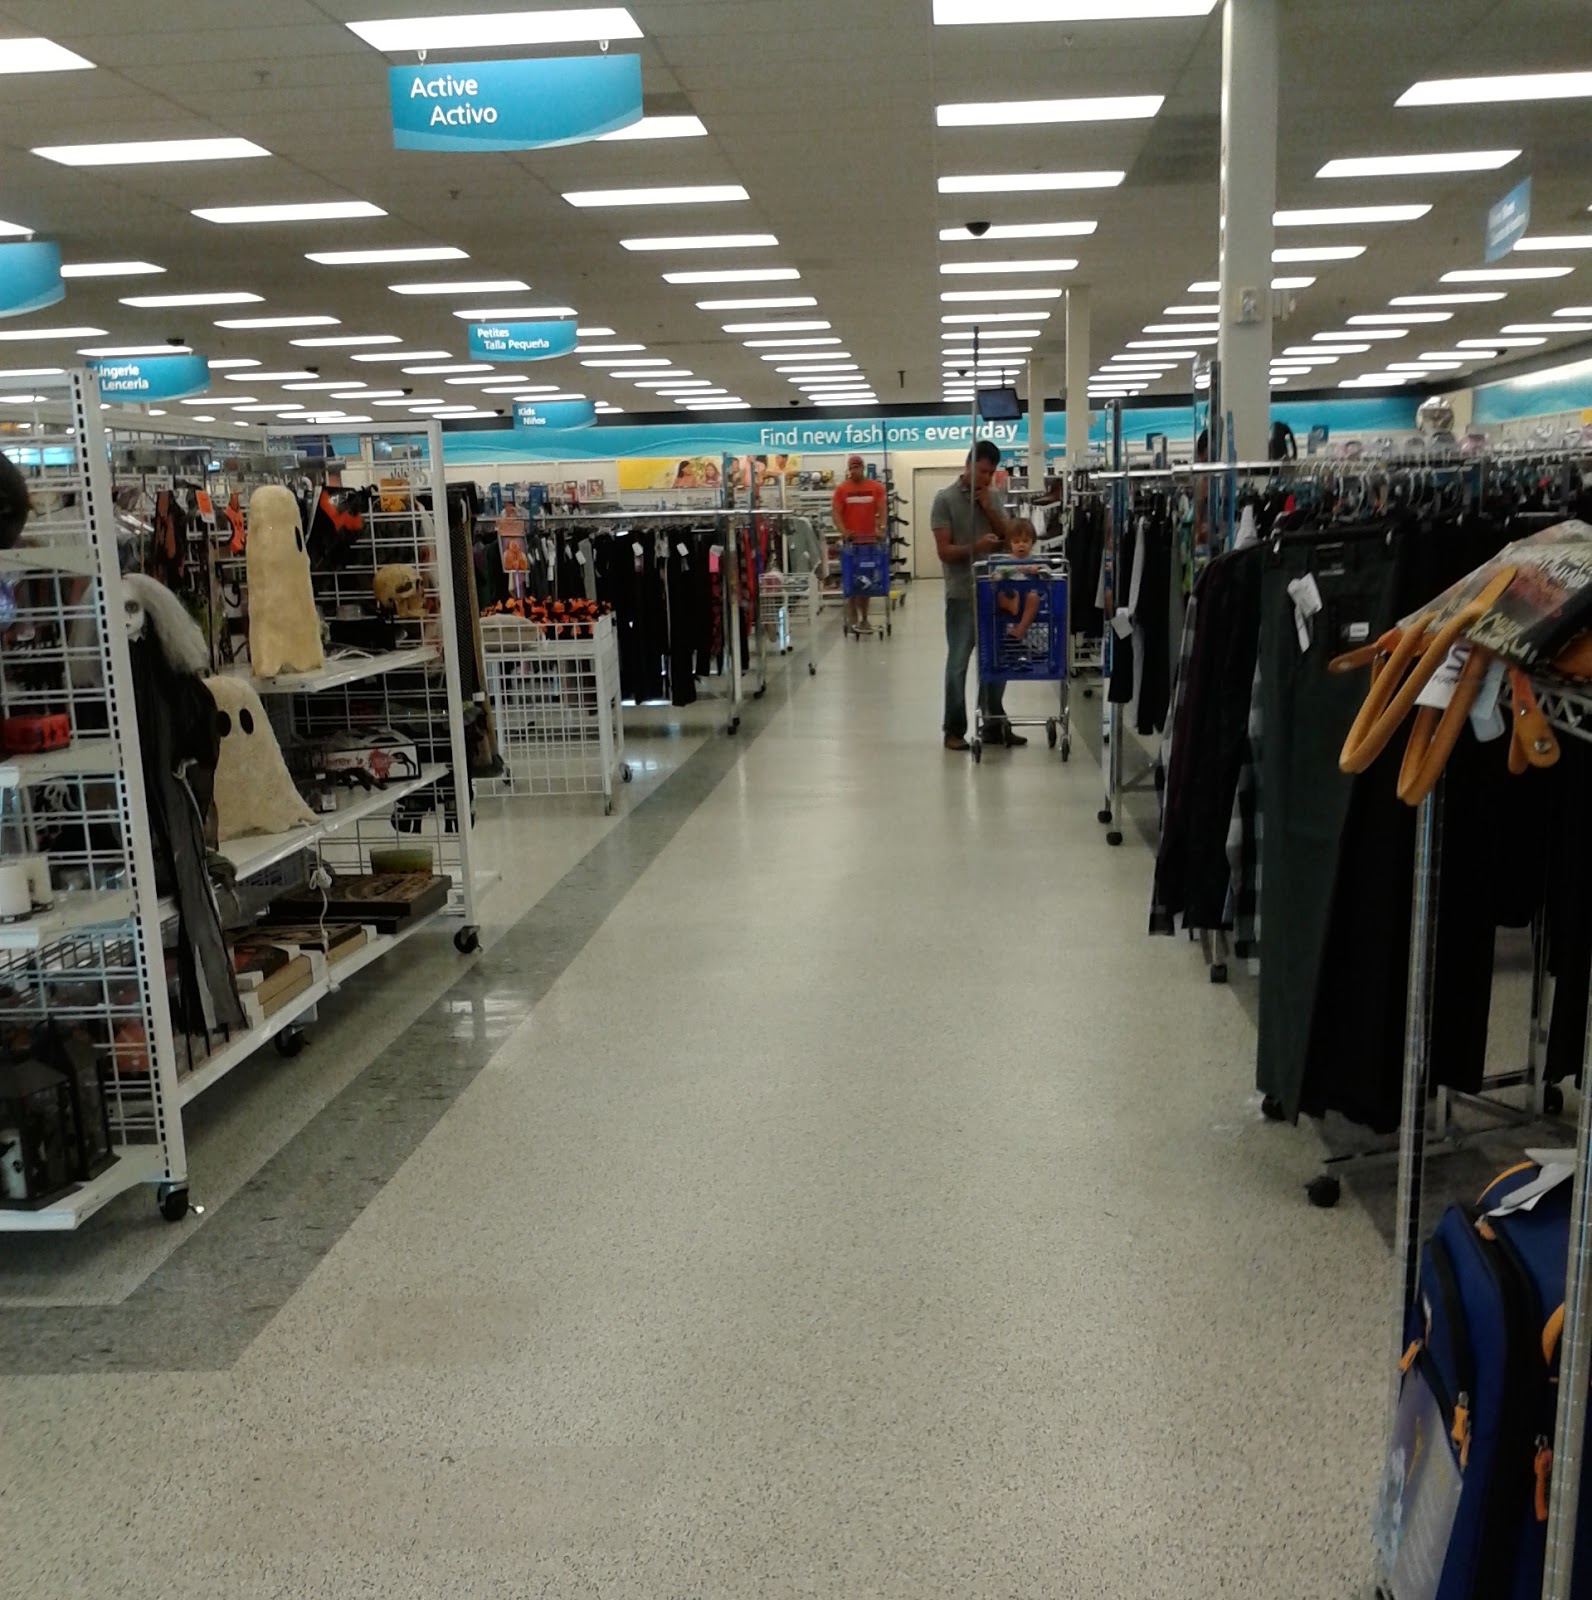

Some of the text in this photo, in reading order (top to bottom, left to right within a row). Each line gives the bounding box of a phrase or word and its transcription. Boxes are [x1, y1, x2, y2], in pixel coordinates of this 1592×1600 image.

[410, 75, 478, 98] Active
[430, 103, 498, 126] Activo
[477, 328, 510, 338] Petites
[484, 339, 507, 350] Talla
[95, 364, 140, 379] ingerie
[518, 407, 536, 416] Kids
[760, 426, 798, 446] Find
[802, 430, 842, 445] new
[845, 424, 920, 443] fashons
